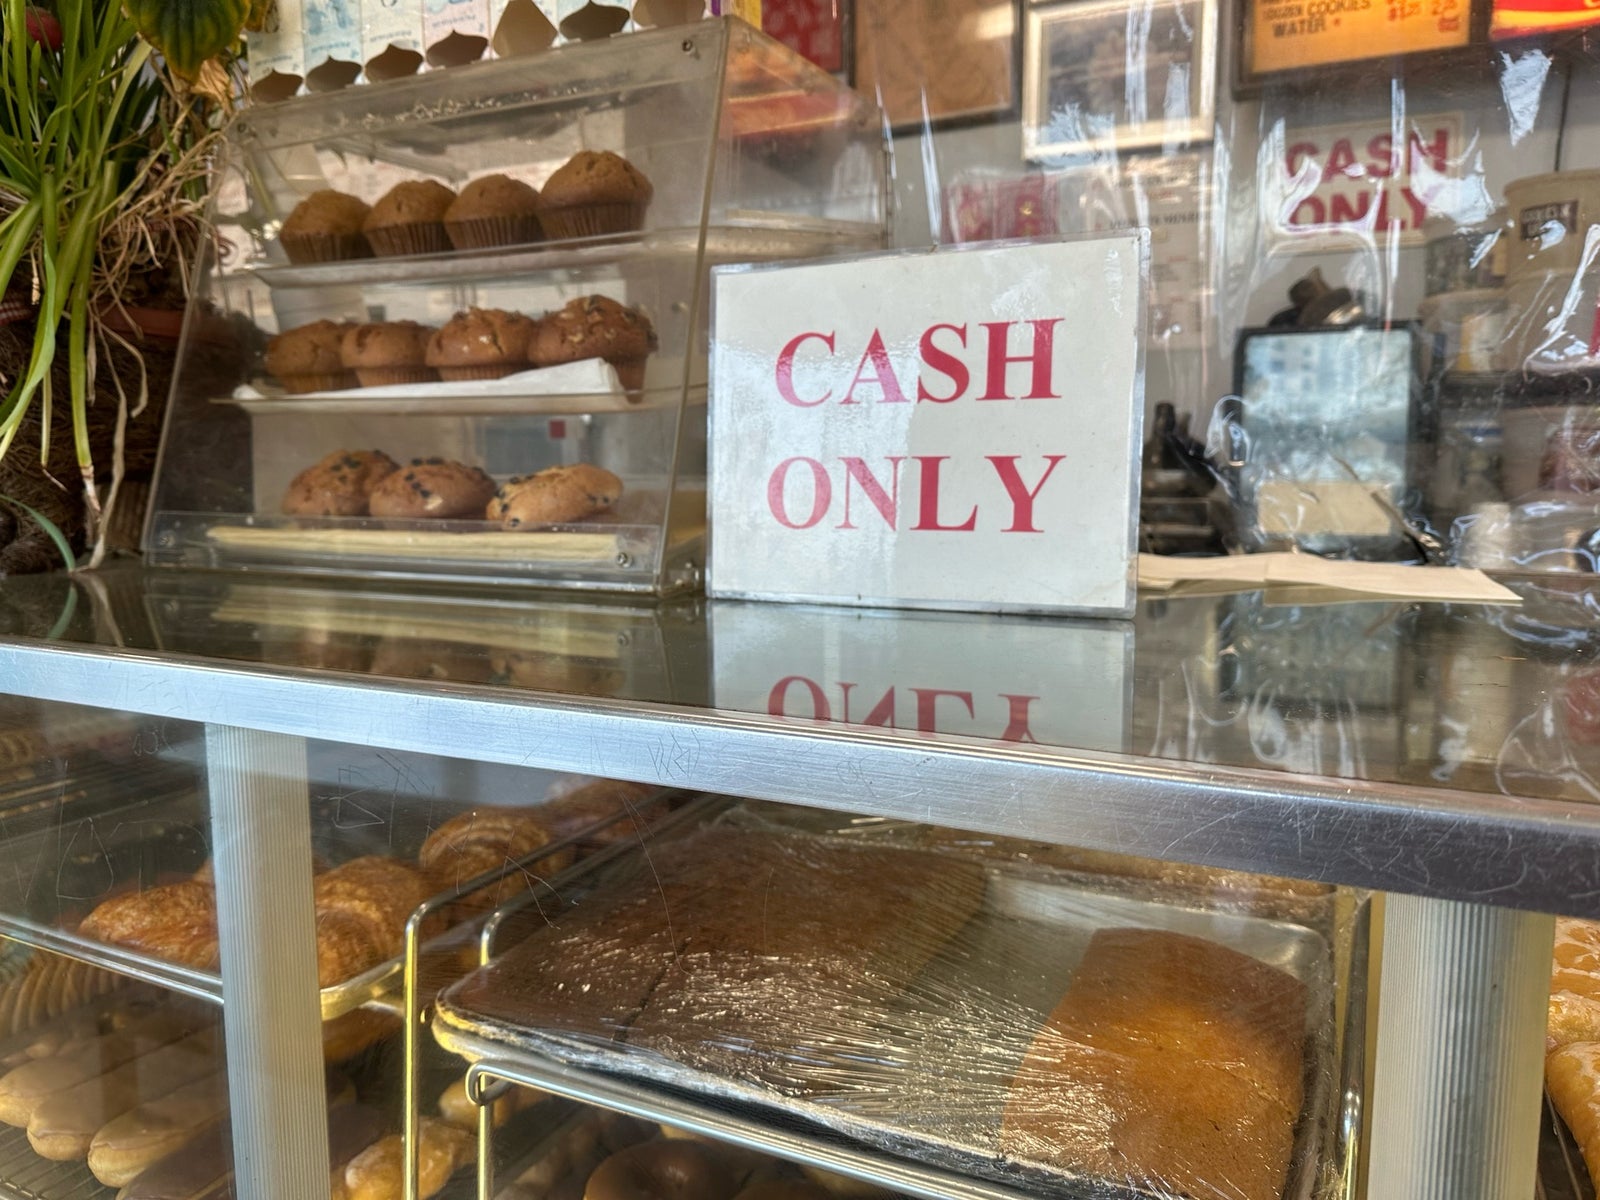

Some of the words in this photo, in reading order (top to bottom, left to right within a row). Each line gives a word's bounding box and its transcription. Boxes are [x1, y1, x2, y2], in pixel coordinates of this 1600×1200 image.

[1272, 17, 1326, 37] WATER
[1285, 128, 1449, 185] CASH
[1287, 186, 1443, 234] ONLY
[775, 317, 1066, 408] CASH
[767, 454, 1067, 533] ONLY
